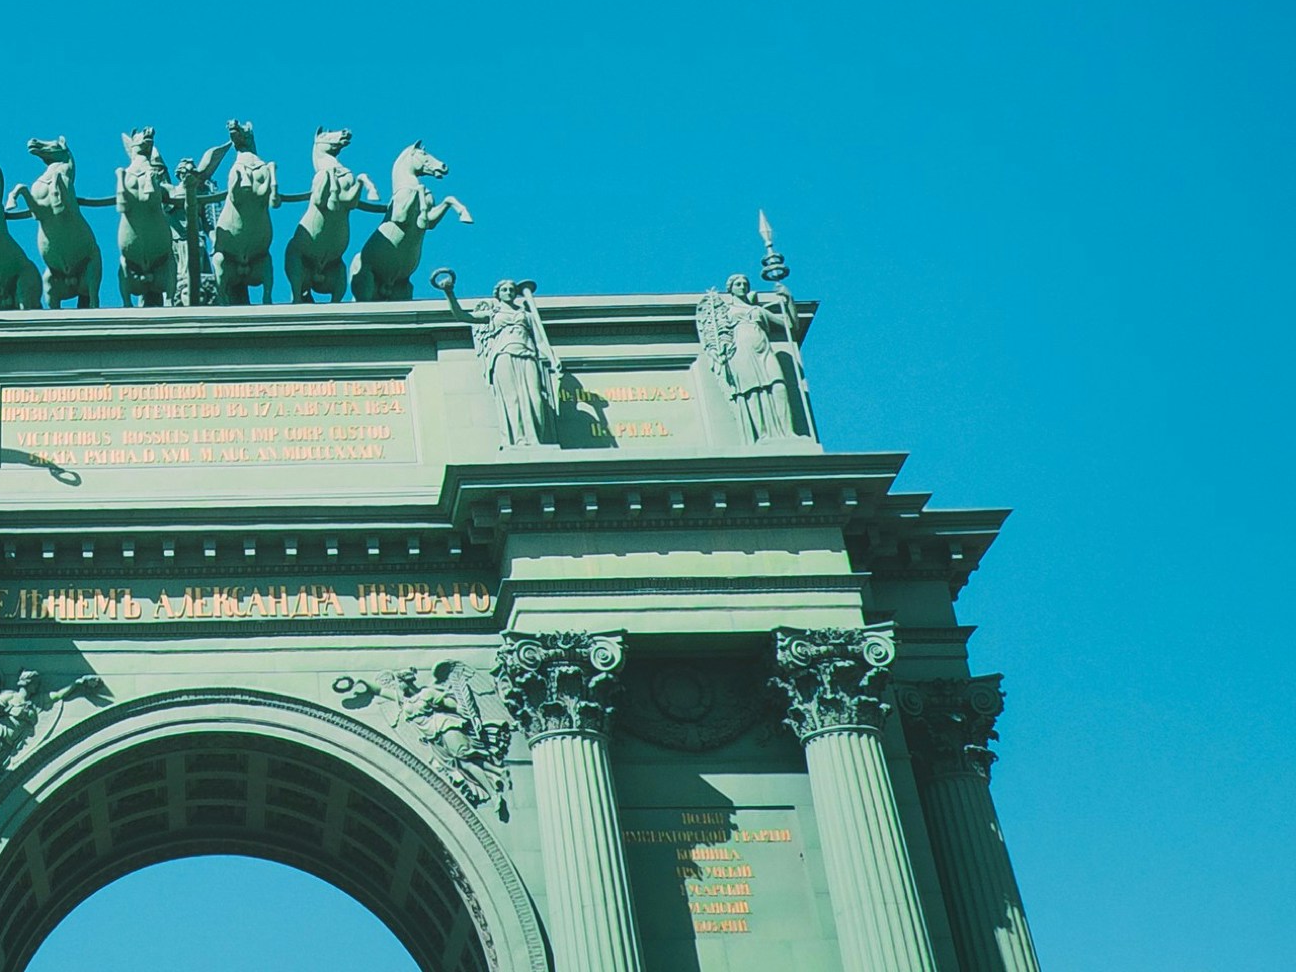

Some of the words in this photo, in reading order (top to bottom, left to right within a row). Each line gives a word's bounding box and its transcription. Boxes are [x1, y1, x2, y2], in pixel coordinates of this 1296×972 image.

[214, 379, 337, 399] ИМПЕРАТОРСКОЙ
[1, 405, 126, 422] ПРИЗНАТЕЛЬНОЕ
[132, 401, 222, 420] ОТЕЧЕСТВО
[227, 401, 249, 418] ВЪ
[255, 400, 271, 416] 17
[293, 399, 361, 416] АВГУСТА
[17, 431, 112, 447] VICTRICIBUS
[122, 429, 189, 445] ROSSICIS
[153, 585, 344, 619] АЛЕКСАНДРА
